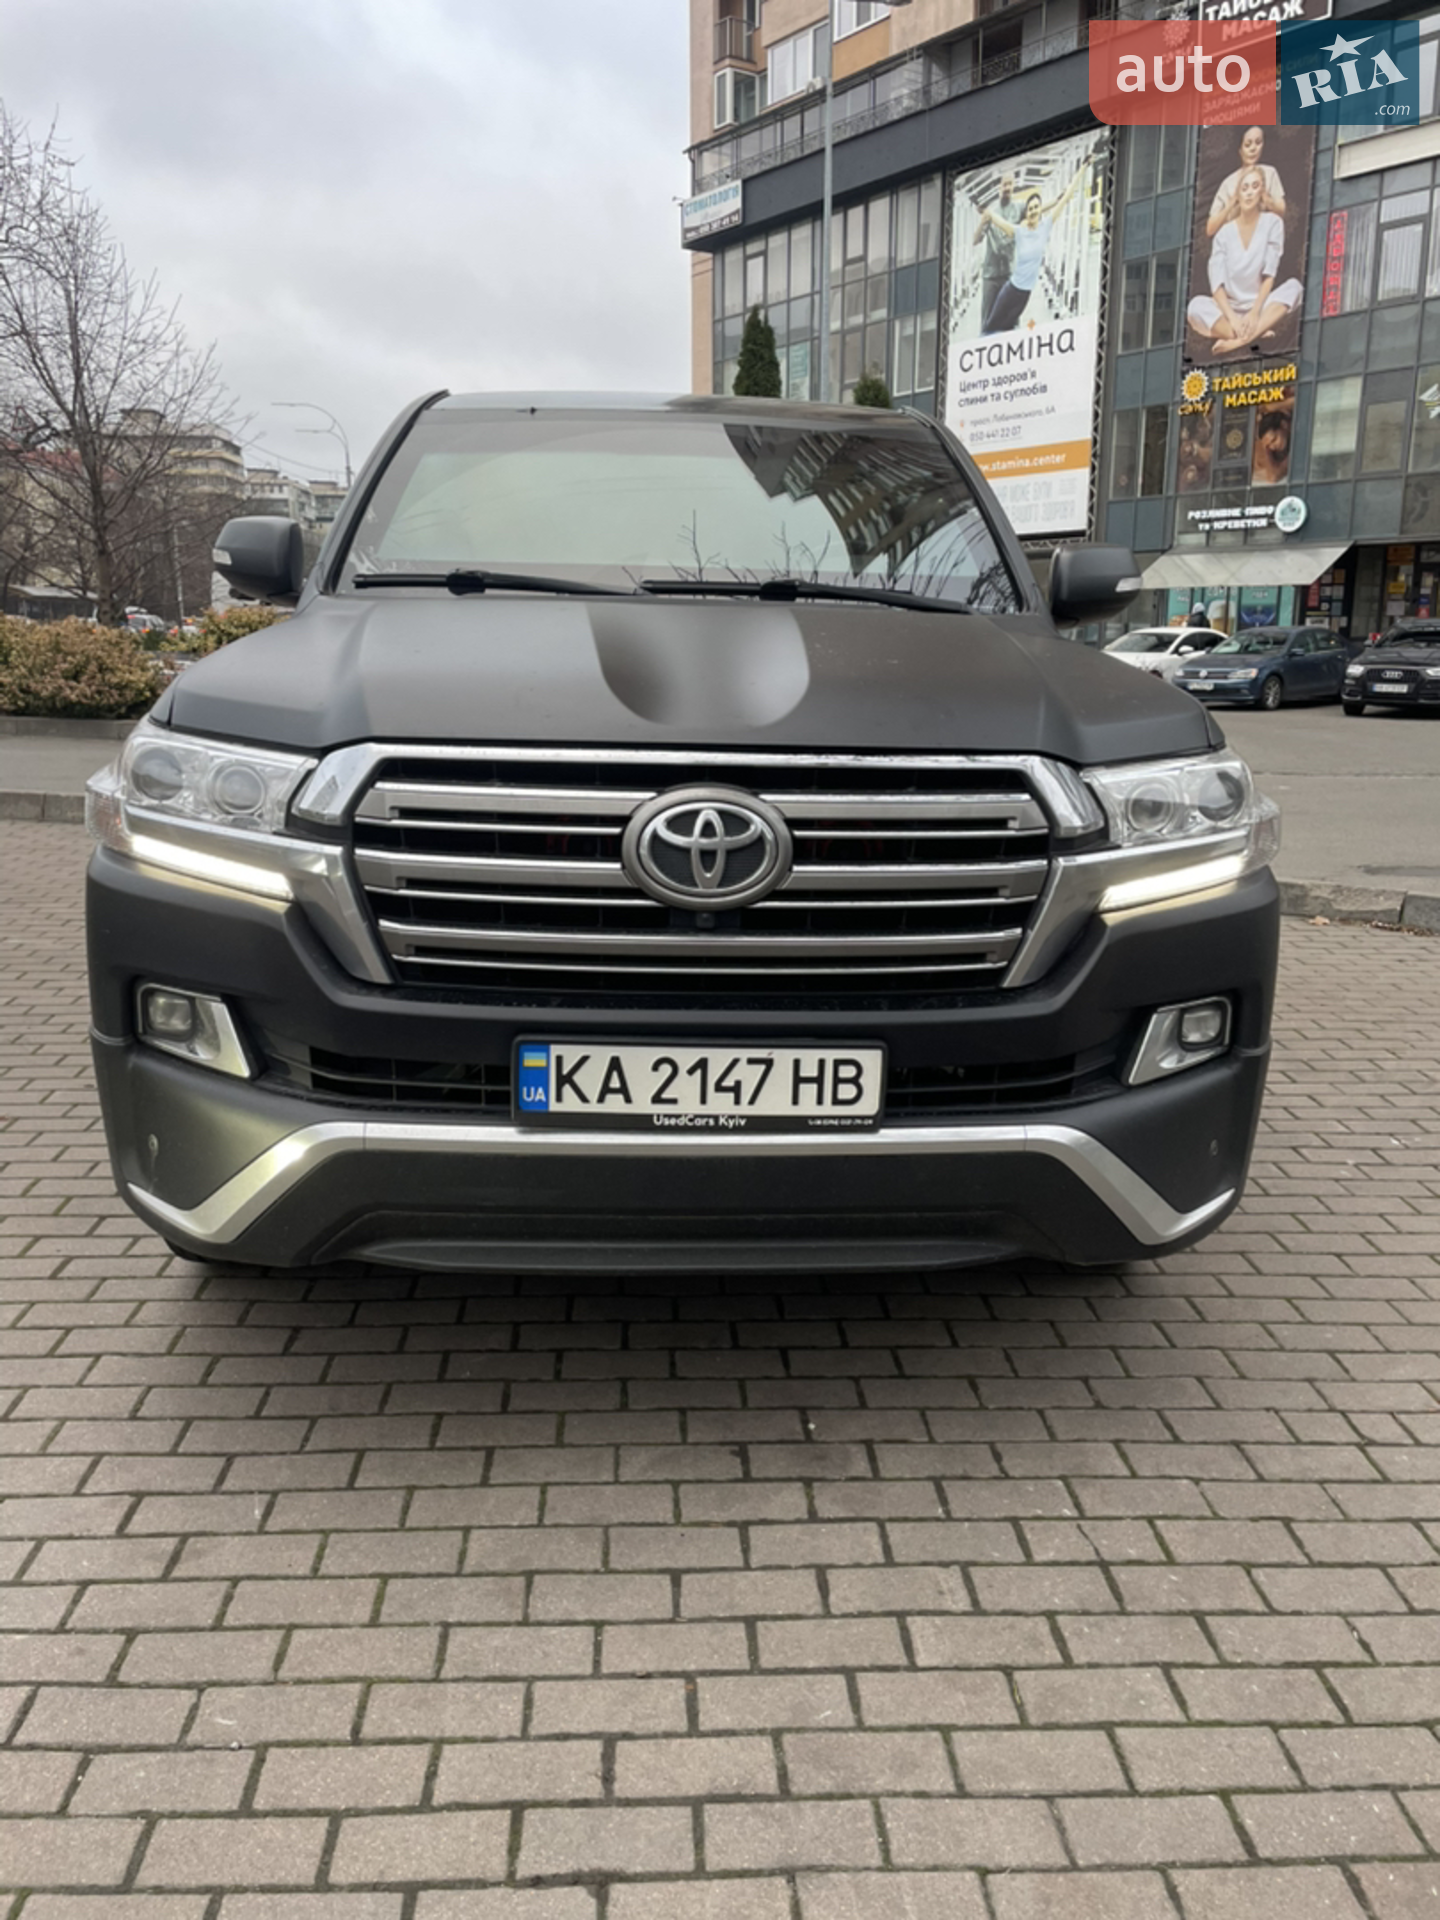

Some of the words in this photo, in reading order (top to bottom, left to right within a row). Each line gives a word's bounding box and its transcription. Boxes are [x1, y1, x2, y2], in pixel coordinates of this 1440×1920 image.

[1222, 0, 1304, 42] МАСАЖ
[959, 328, 1076, 373] стаміна
[959, 376, 990, 394] Центр
[1212, 363, 1298, 393] ТАЙСЬКИЙ
[958, 394, 989, 408] спини
[990, 392, 1002, 403] та
[1003, 382, 1048, 402] суглобів
[1224, 386, 1285, 408] МАСАЖ
[1212, 517, 1268, 530] КРЕВЕТКИ
[522, 1087, 547, 1102] UA
[649, 1056, 775, 1106] 2147
[653, 1114, 715, 1127] UsedCars
[718, 1114, 747, 1128] Kyiv
